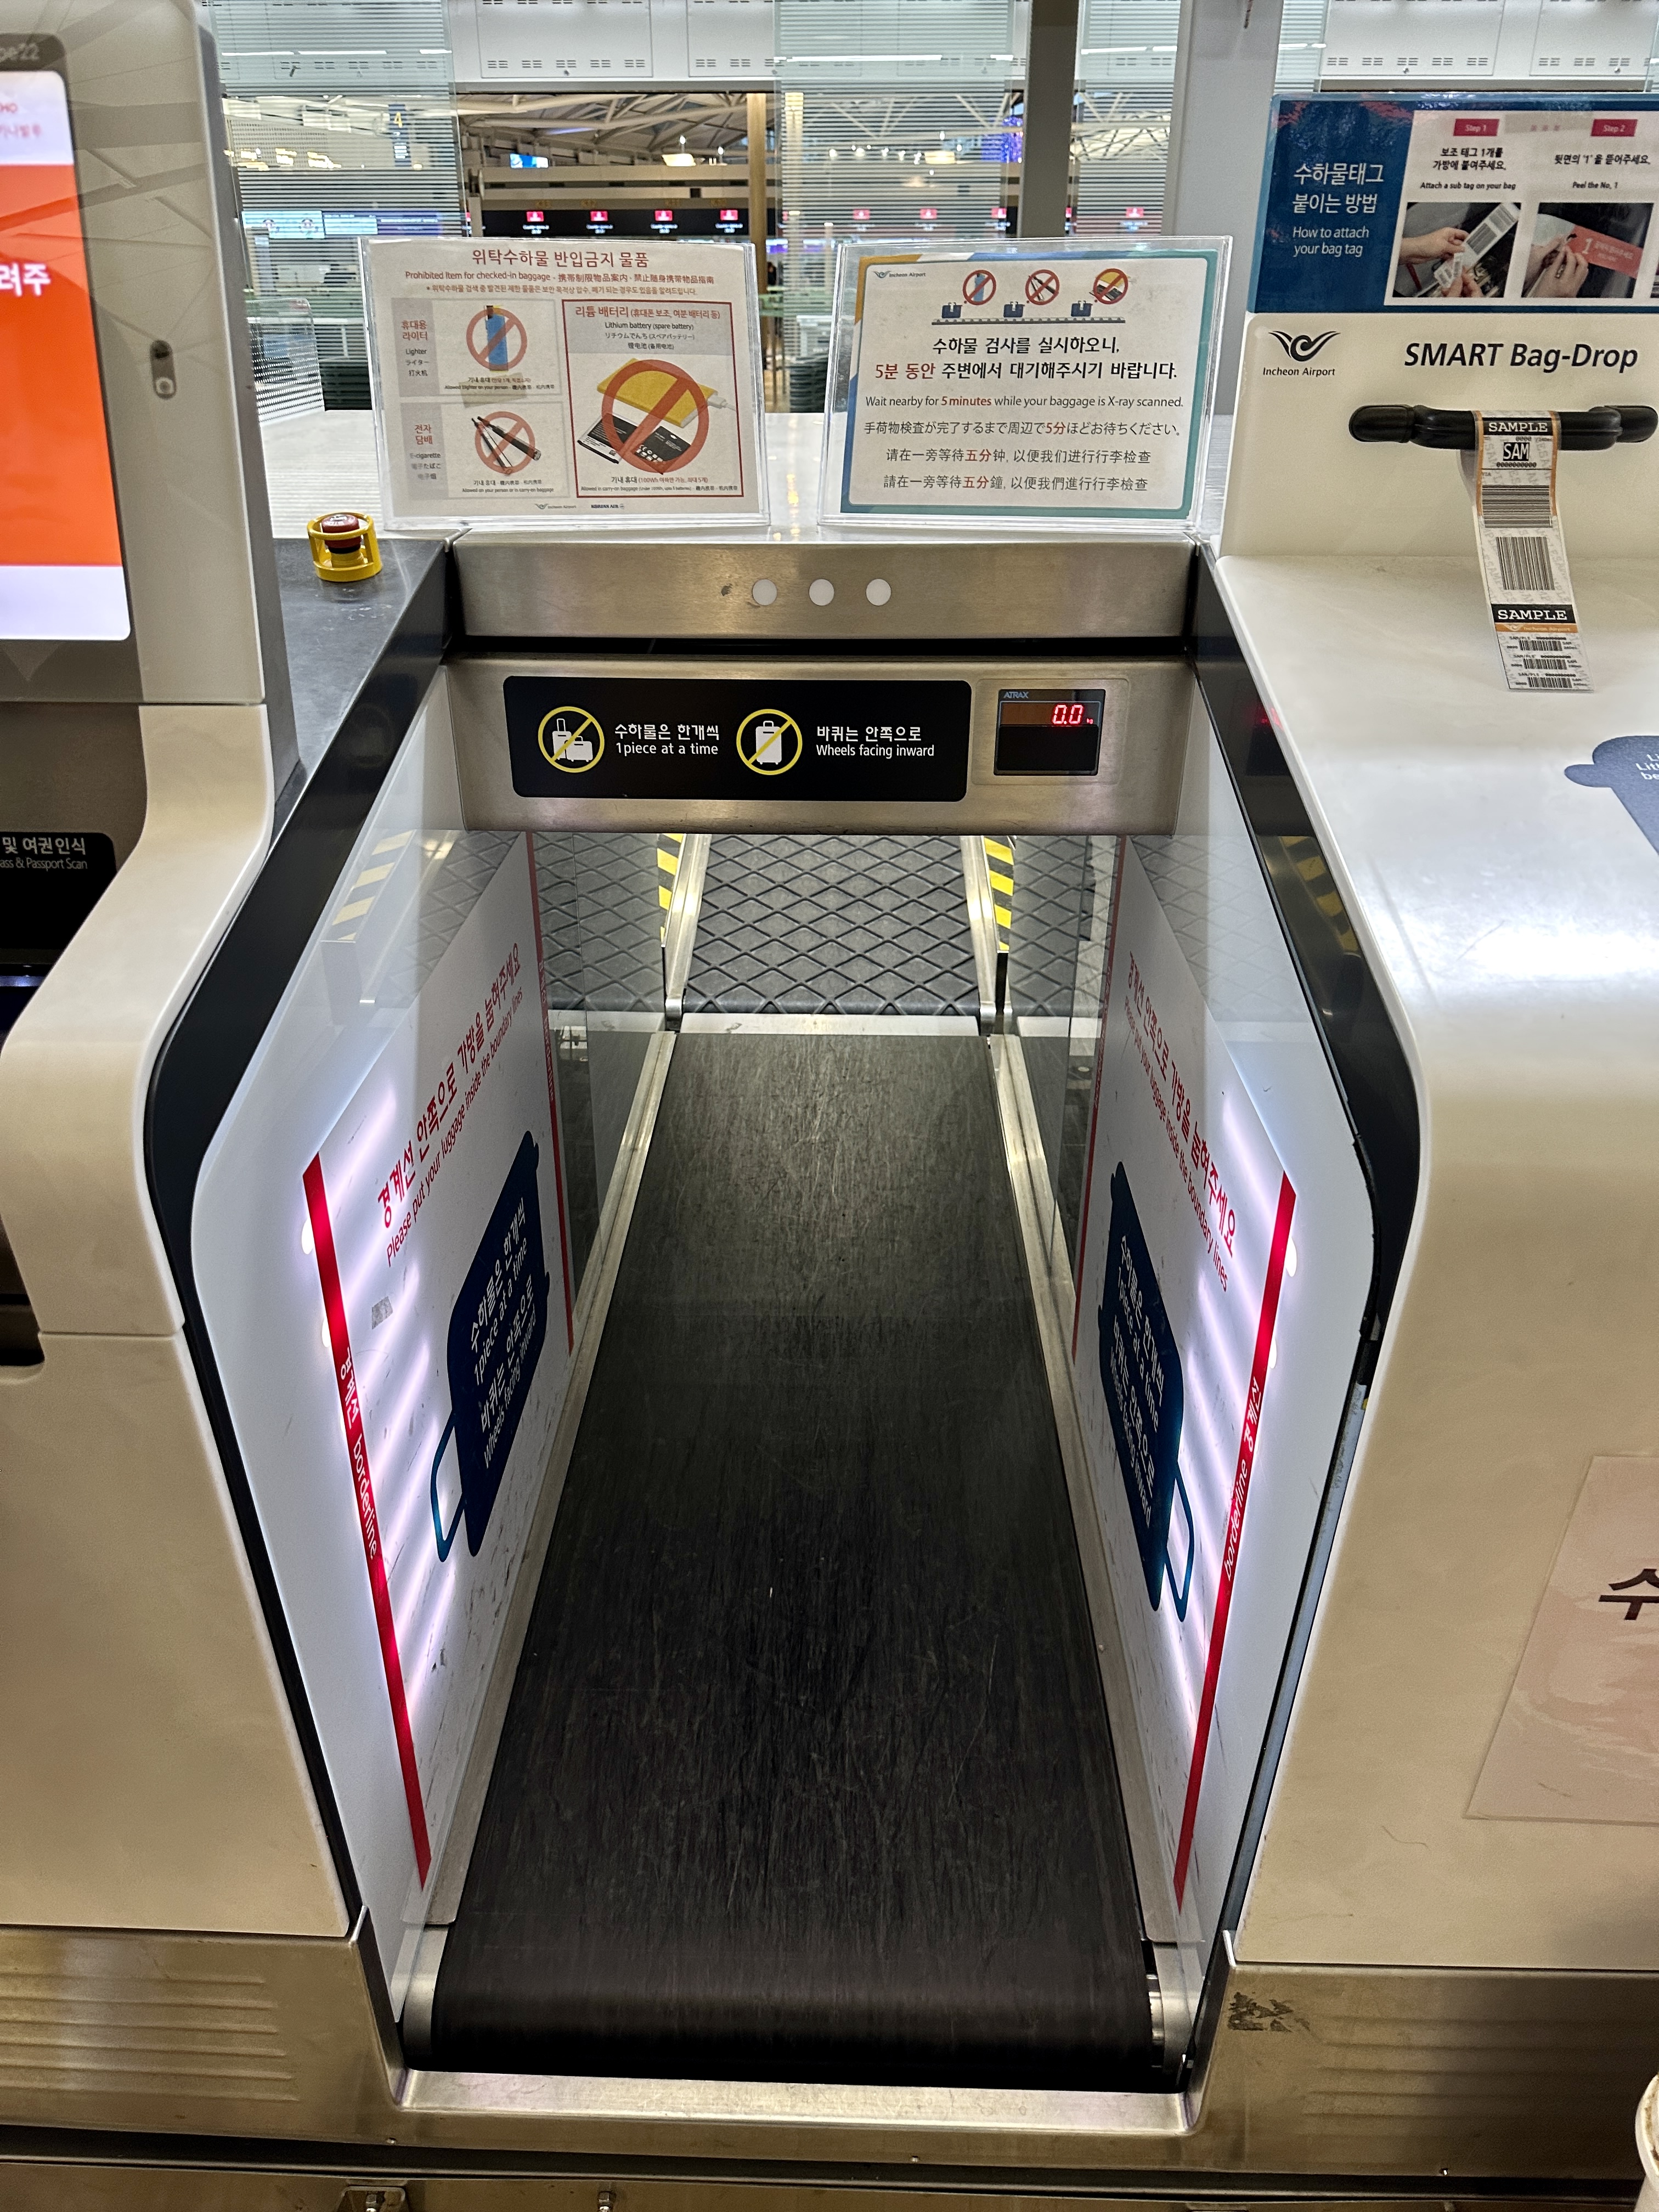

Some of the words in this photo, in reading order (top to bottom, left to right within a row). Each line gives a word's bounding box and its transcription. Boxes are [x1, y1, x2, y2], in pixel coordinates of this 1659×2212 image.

[1465, 125, 1480, 133] Step
[1604, 125, 1619, 133] Step
[1441, 148, 1458, 157] 보조
[1461, 148, 1478, 157] 태그
[1482, 148, 1503, 158] 1개를
[1555, 154, 1580, 165] 뒷면의
[1294, 162, 1384, 185] 수하물태그
[1433, 160, 1458, 170] 가방에
[1503, 182, 1516, 190] bag
[1293, 193, 1341, 213] 붙이는
[1346, 193, 1378, 214] 방법
[1293, 226, 1318, 238] How
[1321, 228, 1331, 238] to
[1334, 225, 1369, 238] attach
[1293, 245, 1319, 257] your
[1322, 242, 1342, 257] bag
[1345, 244, 1363, 257] tag
[472, 249, 549, 267] 위탁수하물
[554, 251, 613, 268] 반입금지
[619, 252, 649, 268] 물품
[405, 271, 443, 279] Prohibited
[477, 272, 516, 280] checked-in
[518, 272, 550, 281] baggage
[576, 307, 596, 318] 리튬
[598, 307, 629, 318] 배터리
[689, 310, 710, 318] 배터리
[401, 320, 428, 330] 휴대용
[402, 331, 428, 341] 라이터
[933, 337, 978, 354] 수하물
[985, 337, 1031, 354] 검사를
[1038, 337, 1119, 354] 실시하오니,
[1404, 343, 1503, 367] SMART
[1510, 343, 1638, 373] Bag-Drop
[875, 363, 899, 380] 5분
[905, 363, 936, 380] 동안
[941, 362, 1002, 379] 주변에서
[1010, 362, 1103, 379] 대기해주시기
[1110, 362, 1177, 379] 바랍니다.
[1262, 366, 1299, 376] Incheon
[1302, 366, 1335, 379] Airport
[865, 396, 887, 407] Wait
[889, 396, 923, 409] nearby
[925, 395, 939, 407] for
[941, 396, 947, 406] 5
[949, 396, 992, 407] minutes
[995, 396, 1022, 407] while
[1024, 398, 1048, 409] your
[1049, 396, 1096, 409] baggage
[1098, 396, 1105, 407] is
[1108, 396, 1135, 409] X-ray
[1137, 396, 1183, 408] scanned.
[415, 424, 432, 434] 전자
[864, 421, 1180, 437] 手荷物検査が完了するまで周辺で5分ほどお待ちください。
[1488, 422, 1548, 432] SAMPLE
[415, 435, 432, 445] 담배
[1503, 443, 1529, 460] SAM
[1498, 610, 1567, 620] SAMPLE
[1053, 704, 1084, 724] 0.0
[614, 724, 671, 740] 수하물은
[678, 724, 719, 741] 한개씩
[817, 726, 858, 741] 바퀴는
[866, 726, 921, 742] 안쪽으로
[661, 743, 674, 754] at
[678, 745, 685, 754] a
[690, 742, 718, 754] time
[816, 744, 855, 756] Wheels
[859, 744, 893, 759] facing
[896, 744, 934, 756] inward
[2, 837, 18, 854] 및
[15, 856, 25, 868] &
[26, 856, 65, 872] Passport
[66, 857, 87, 869] Scan
[377, 1139, 416, 1228] 경계선
[417, 1061, 457, 1163] 안쪽으로
[458, 1012, 484, 1075] 가방을
[485, 943, 521, 1032] 눕혀주세요
[386, 1211, 412, 1268] Please
[413, 1180, 426, 1223] put
[426, 1150, 441, 1197] your
[441, 1104, 465, 1159] luggage
[465, 1071, 482, 1110] inside
[481, 1052, 491, 1077] the
[490, 1007, 512, 1059] boundary
[512, 986, 523, 1015] lines
[1143, 996, 1170, 1082] 안쪽으로
[1172, 1059, 1190, 1144] 가방을
[1191, 1120, 1236, 1259] 눕혀주세요
[1150, 1065, 1167, 1122] luggage
[1166, 1110, 1180, 1159] inside
[1179, 1148, 1188, 1183] the
[1187, 1171, 1214, 1254] boundary
[1213, 1240, 1229, 1293] lines
[471, 1259, 503, 1354] 수하물은
[504, 1197, 526, 1271] 한개씩
[499, 1289, 507, 1321] at
[508, 1278, 513, 1298] a
[512, 1237, 527, 1282] time
[1121, 1235, 1143, 1331] 수하물은
[481, 1362, 506, 1434] 바퀴는
[506, 1274, 534, 1369] 안쪽으로
[1145, 1371, 1159, 1434] time
[1243, 1376, 1262, 1453] 경계선
[1129, 1385, 1155, 1498] 안쪽으로
[340, 1346, 359, 1429] 경계선
[352, 1433, 377, 1560] borderline
[1223, 1458, 1248, 1581] borderline
[1598, 1568, 1659, 1621] 수
